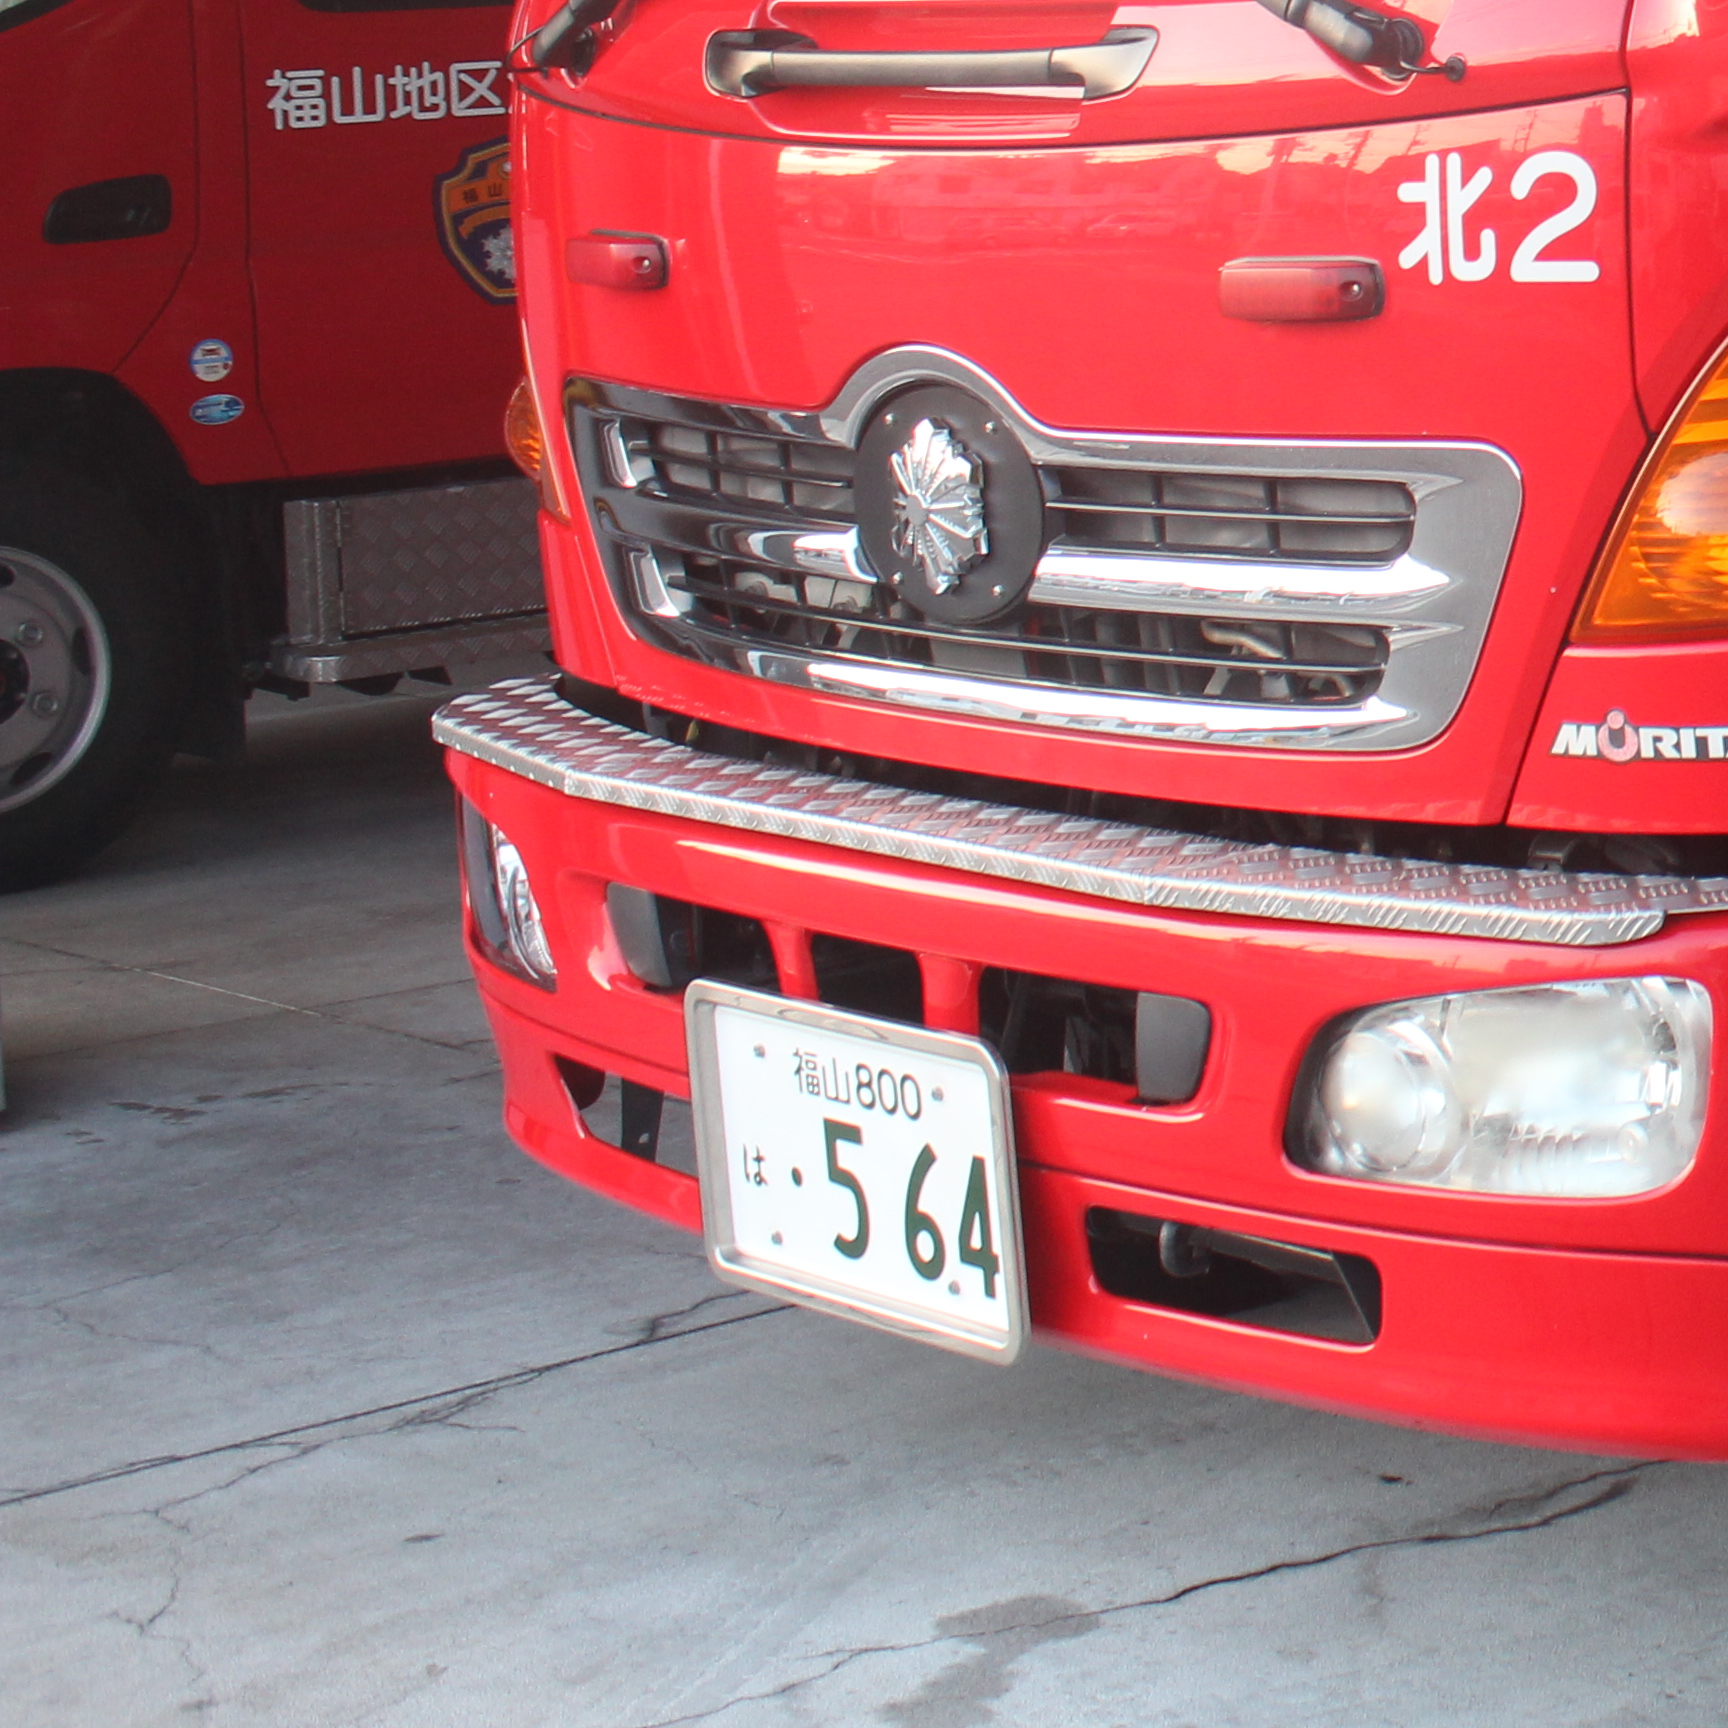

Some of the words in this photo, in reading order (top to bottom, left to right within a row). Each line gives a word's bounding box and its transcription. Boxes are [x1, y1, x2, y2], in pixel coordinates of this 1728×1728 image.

[265, 61, 513, 131] 福山地区
[1397, 151, 1600, 286] 北2
[744, 1144, 767, 1186] は
